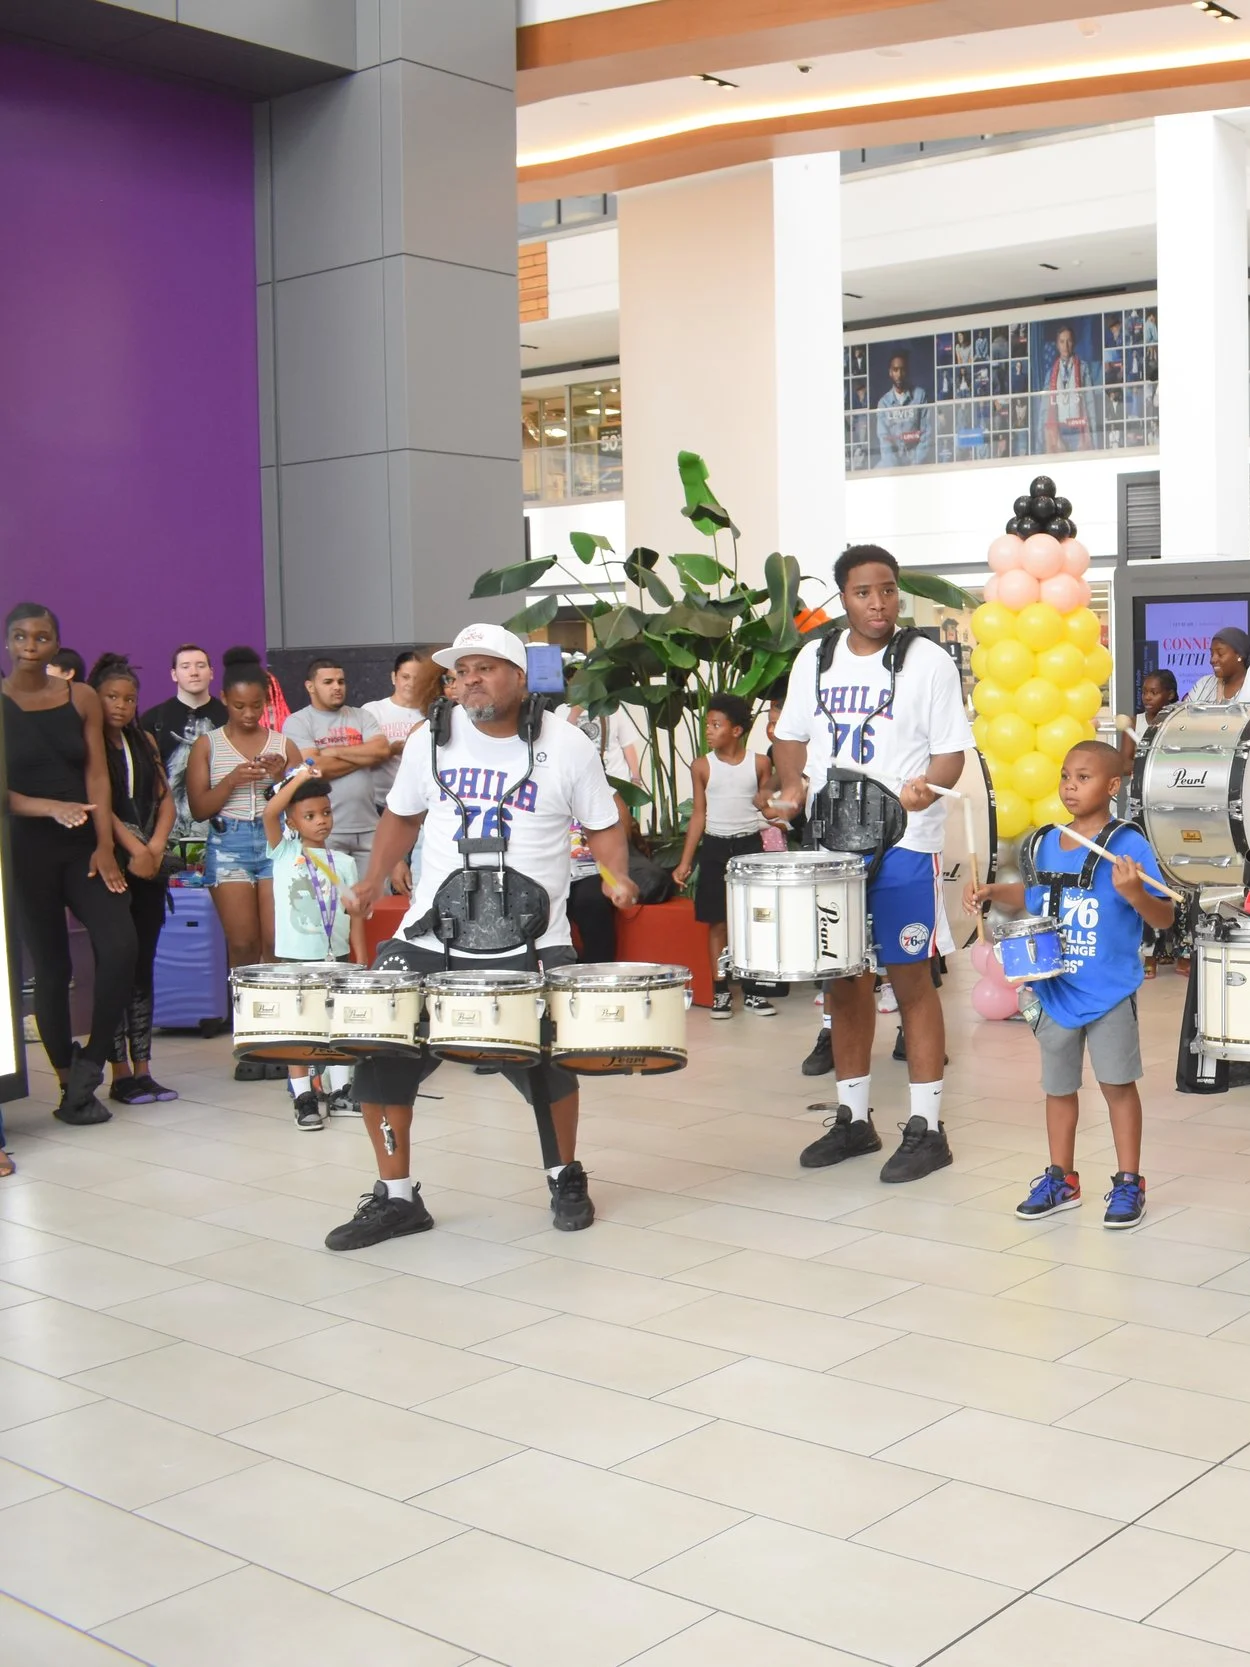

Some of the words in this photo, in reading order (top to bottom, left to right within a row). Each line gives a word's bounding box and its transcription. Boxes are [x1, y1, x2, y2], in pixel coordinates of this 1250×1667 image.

[1163, 637, 1211, 651] CONNE
[1167, 653, 1205, 666] WITH
[814, 686, 894, 720] PHILA
[828, 722, 875, 764] 76
[438, 767, 539, 813] PHILA
[1167, 768, 1208, 788] Pearl
[452, 805, 513, 841] 76
[817, 894, 840, 959] Pearl
[1063, 896, 1099, 929] 76
[903, 935, 926, 947] 76ers
